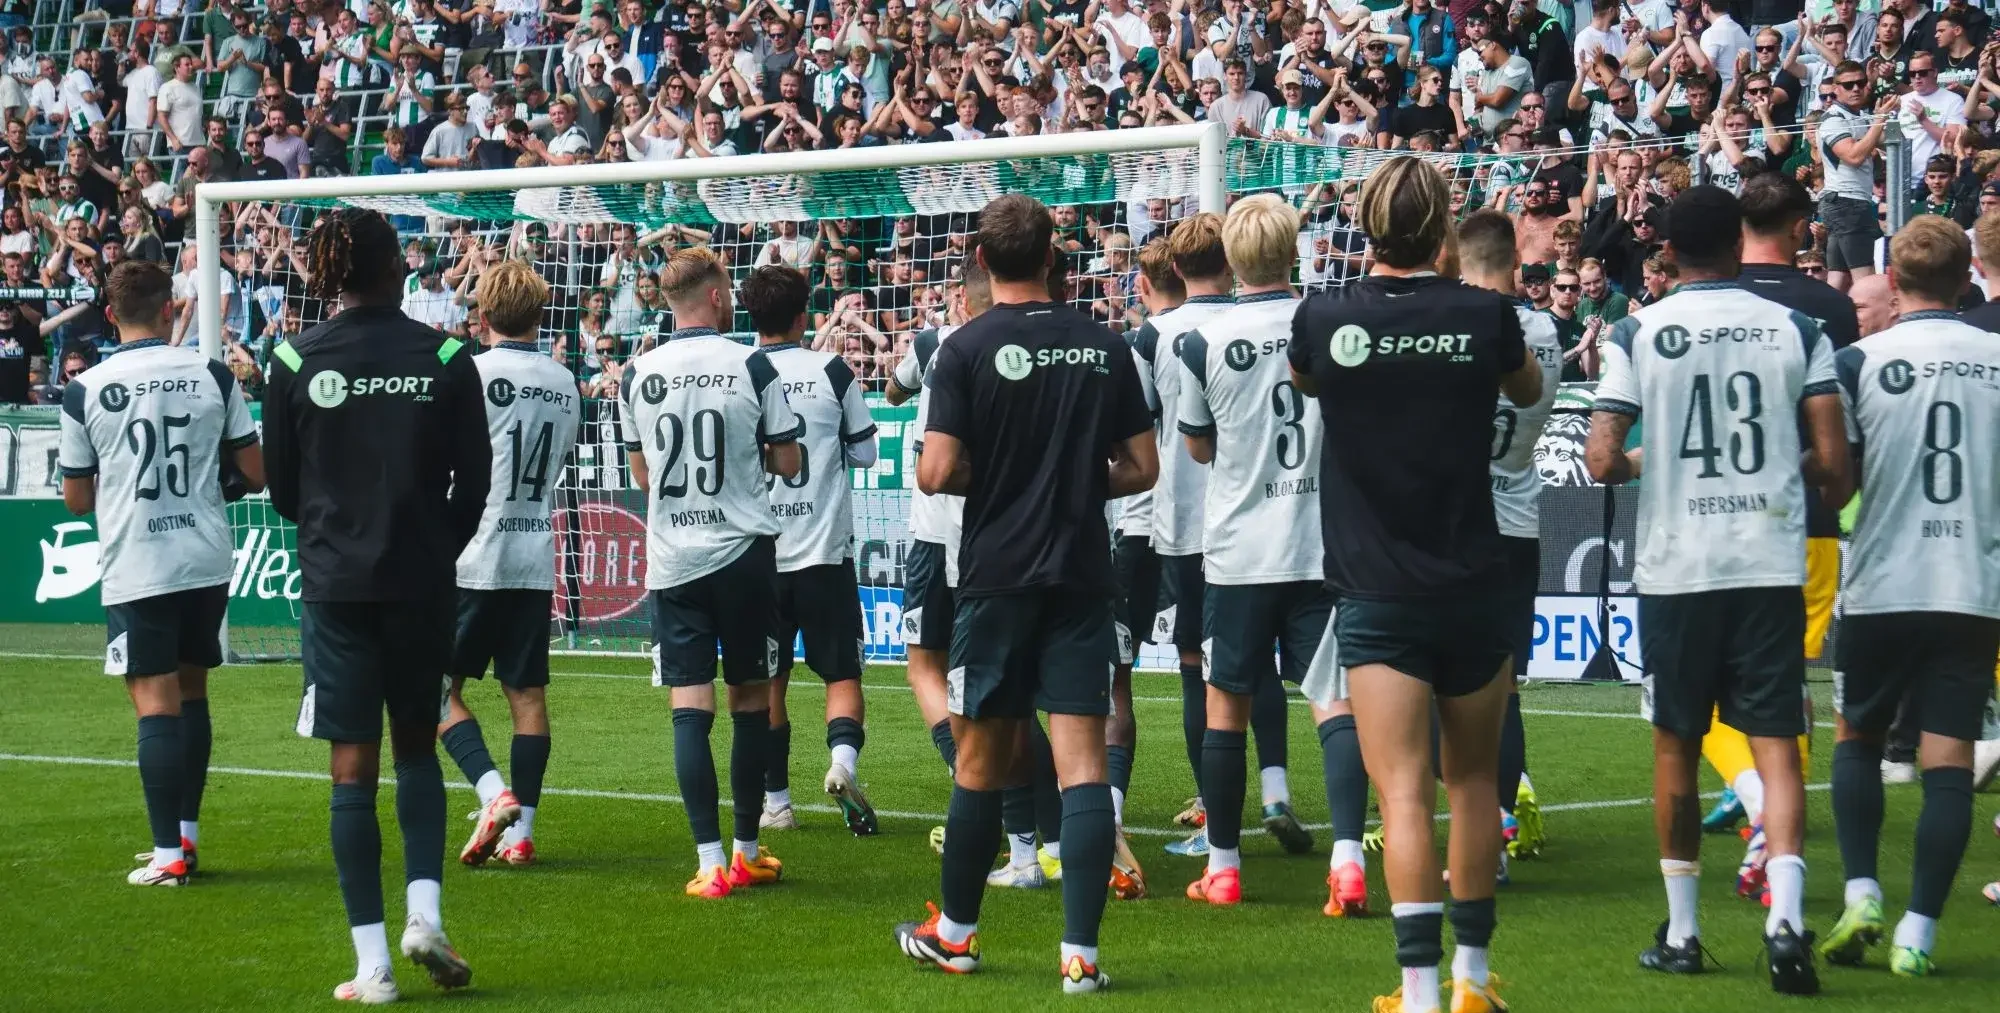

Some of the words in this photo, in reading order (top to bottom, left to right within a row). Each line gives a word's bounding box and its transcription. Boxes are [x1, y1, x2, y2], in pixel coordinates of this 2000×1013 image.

[1377, 334, 1473, 354] SPORT
[1697, 327, 1780, 345] SPORT
[1036, 347, 1108, 367] SPORT
[1449, 354, 1473, 362] .COM
[1922, 361, 2000, 381] SPORT
[135, 379, 200, 397] SPORT
[352, 377, 434, 396] SPORT
[671, 375, 737, 390] SPORT
[520, 386, 572, 407] SPORT
[1272, 380, 1306, 470] 3
[1679, 371, 1765, 478] 43
[128, 413, 192, 502] 25
[506, 420, 554, 502] 14
[655, 408, 725, 500] 29
[1923, 401, 1962, 504] 8
[1688, 493, 1768, 516] PEERSMAN
[148, 513, 196, 533] OOSTING
[671, 508, 727, 528] POSTEMA
